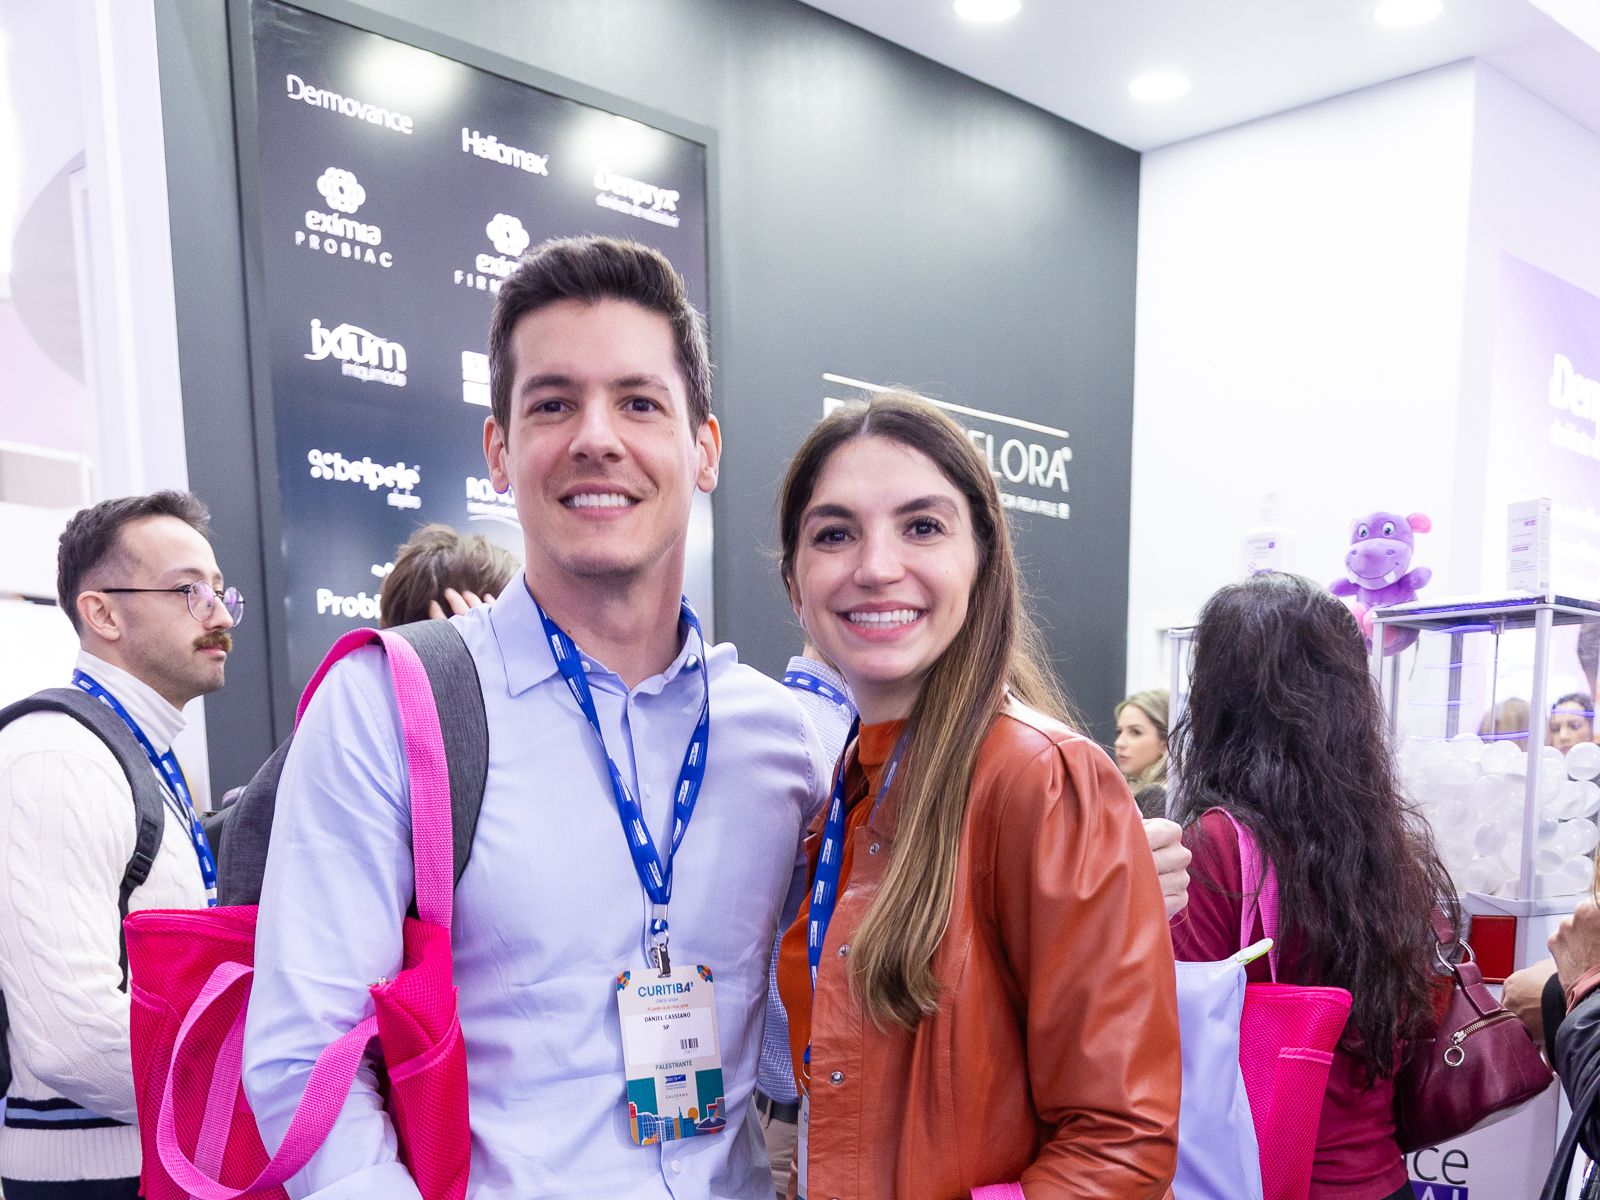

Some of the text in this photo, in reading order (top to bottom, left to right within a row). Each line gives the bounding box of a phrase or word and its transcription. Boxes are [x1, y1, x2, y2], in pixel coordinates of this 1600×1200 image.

[286, 74, 413, 134] Dermovance
[295, 231, 393, 268] PROBIAC
[664, 1011, 691, 1020] CASSIANO
[655, 1060, 693, 1070] PALESTRANTE
